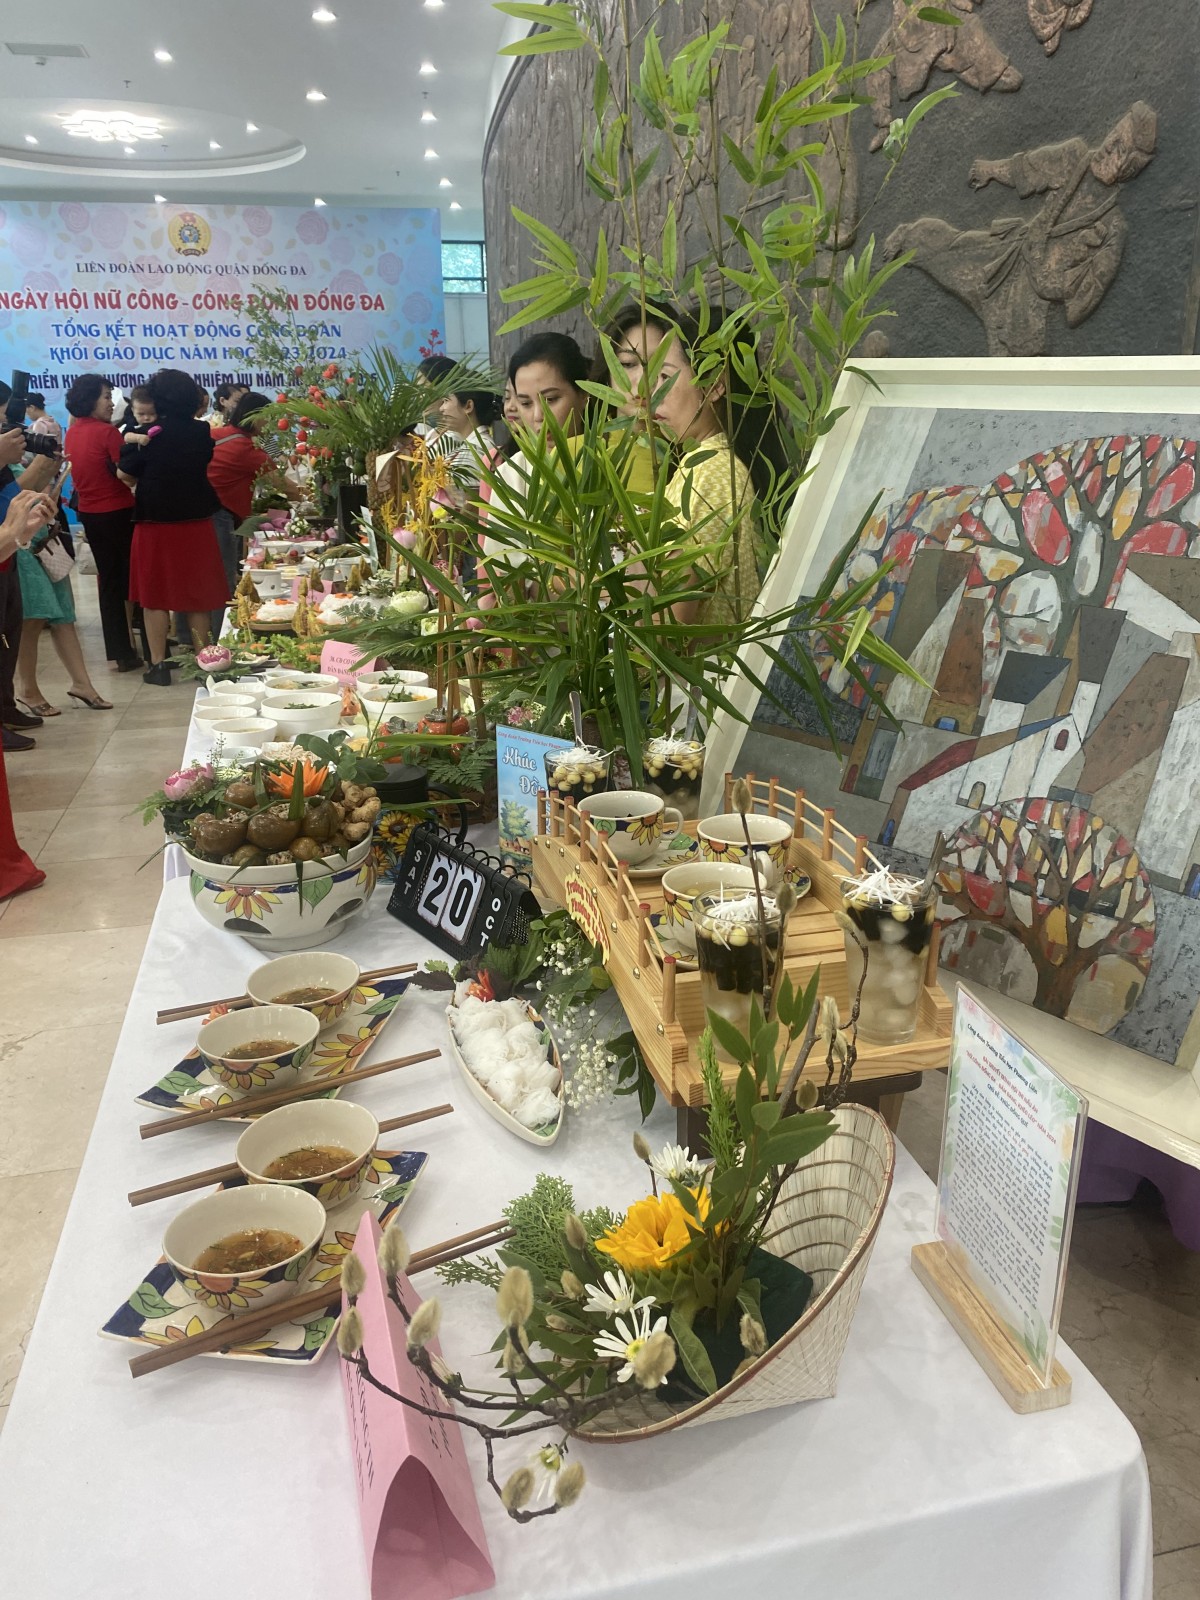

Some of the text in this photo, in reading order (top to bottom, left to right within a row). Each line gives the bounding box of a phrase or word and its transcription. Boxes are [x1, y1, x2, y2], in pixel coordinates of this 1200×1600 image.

[76, 261, 307, 277] LIÊN ĐOÀN LAO ĐỘNG QUẬN ĐỐNG ĐA
[0, 287, 48, 310] NGÀY
[54, 288, 89, 313] HỘI
[94, 288, 121, 310] NỮ
[127, 288, 179, 310] CÔNG
[192, 289, 243, 311] CÔNG
[303, 287, 355, 311] ĐỐNG
[360, 294, 385, 311] ĐA
[51, 316, 100, 337] TỔNG
[105, 317, 137, 341] KẾT
[142, 323, 189, 341] HOẠT
[194, 320, 241, 341] ĐỘNG
[50, 340, 88, 364] KHỐI
[93, 342, 135, 360] GIÁO
[140, 346, 175, 363] DỤC
[180, 343, 217, 360] NĂM
[30, 368, 59, 389] RIỂN
[256, 371, 284, 387] NĂM
[502, 746, 537, 771] Khúc
[519, 776, 546, 797] Đồ
[403, 850, 423, 894] SAT
[423, 867, 474, 927] 20
[480, 897, 501, 947] OCT
